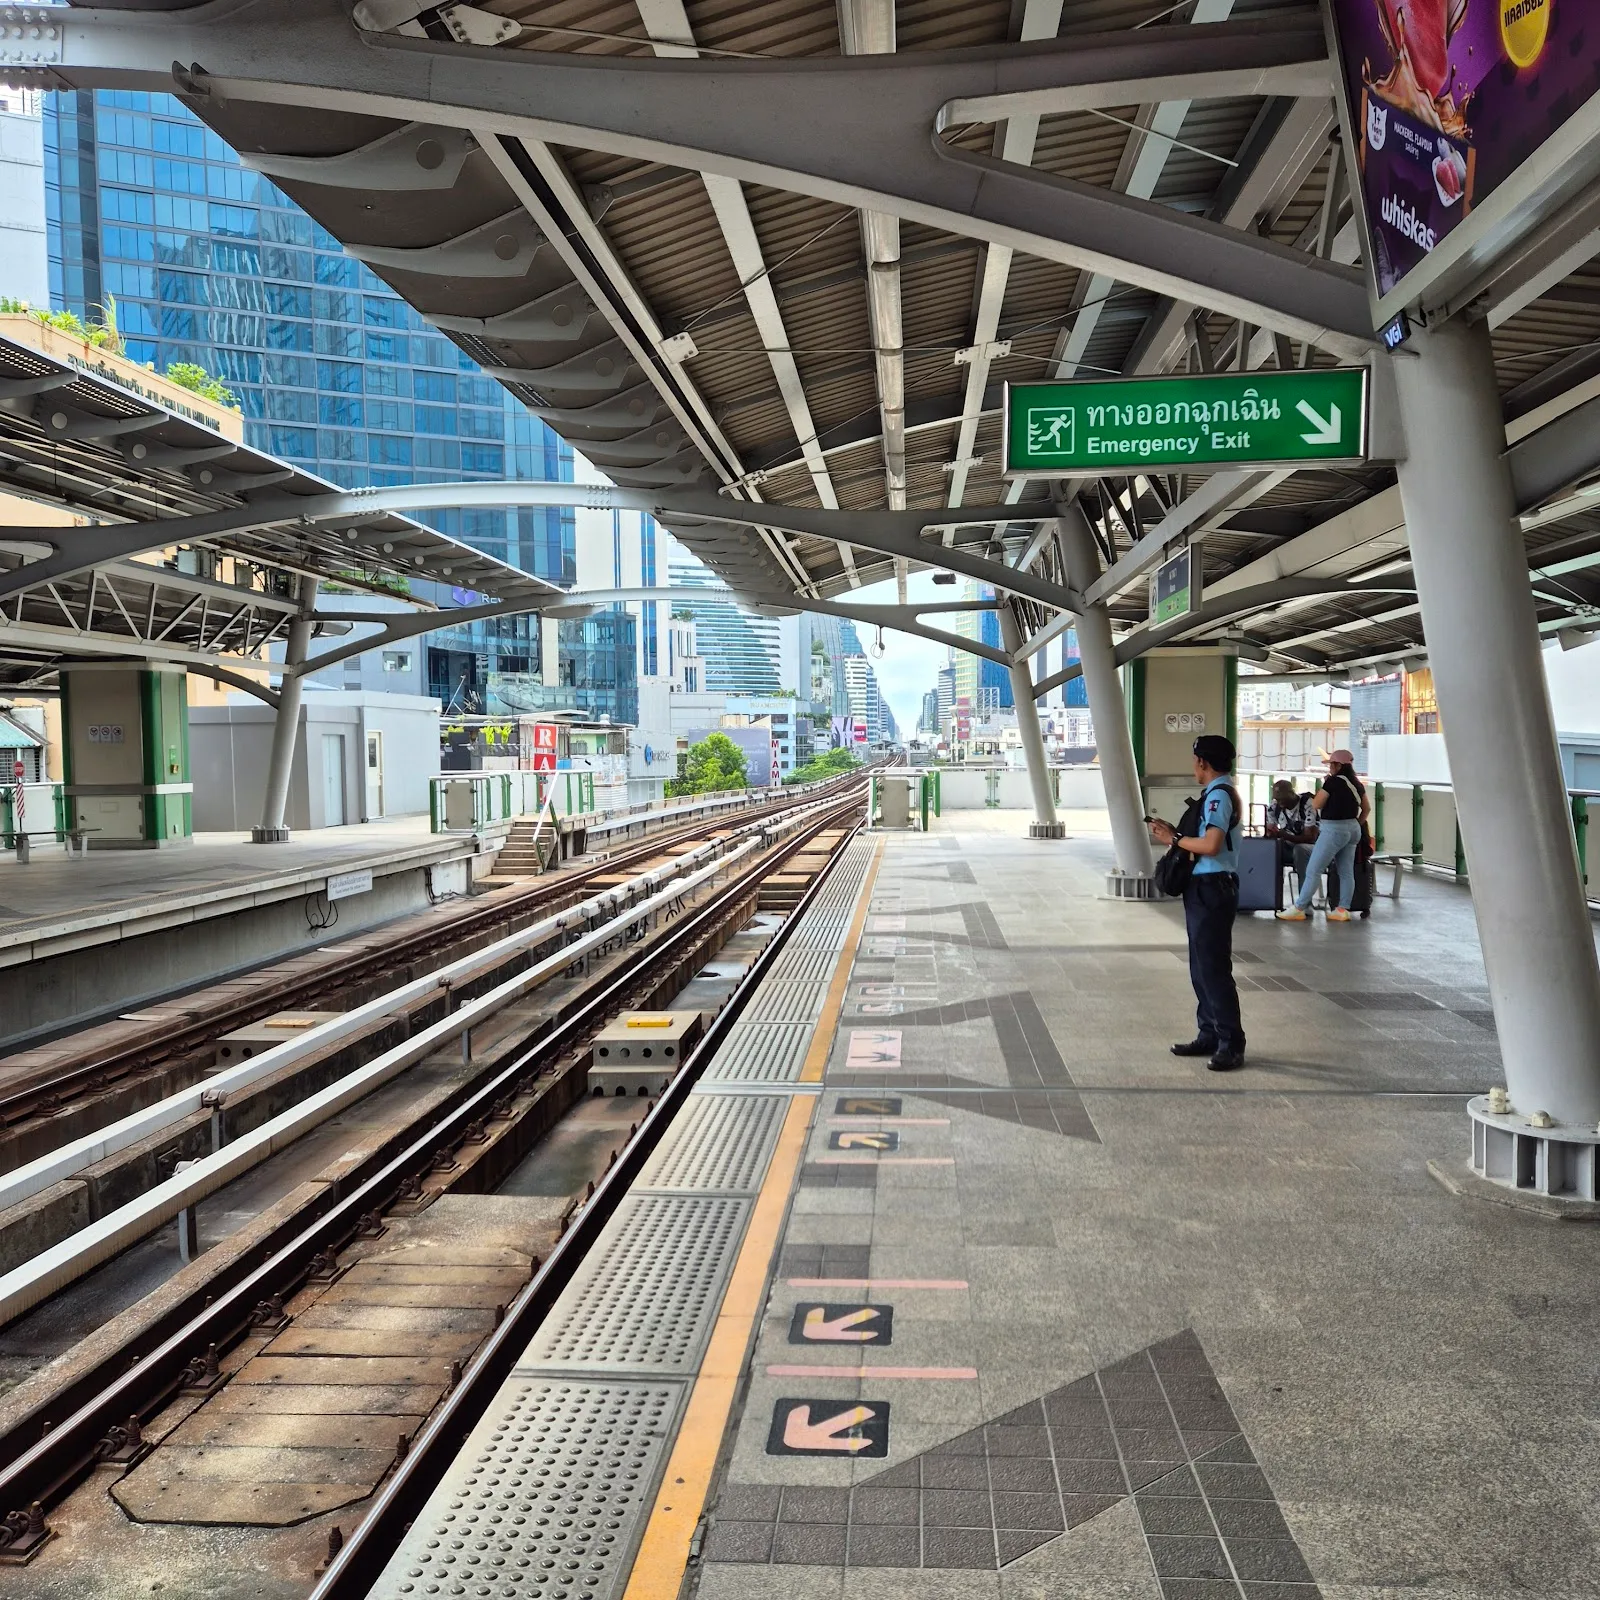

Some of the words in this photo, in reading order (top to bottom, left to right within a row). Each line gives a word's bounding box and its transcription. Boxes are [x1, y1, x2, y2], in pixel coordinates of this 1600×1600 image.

[1382, 193, 1435, 253] whiskas
[1086, 388, 1281, 435] ทางออกฉุกเฉิน
[1087, 436, 1200, 456] Emergency
[1212, 431, 1251, 450] Exit
[771, 739, 780, 787] MIAMI
